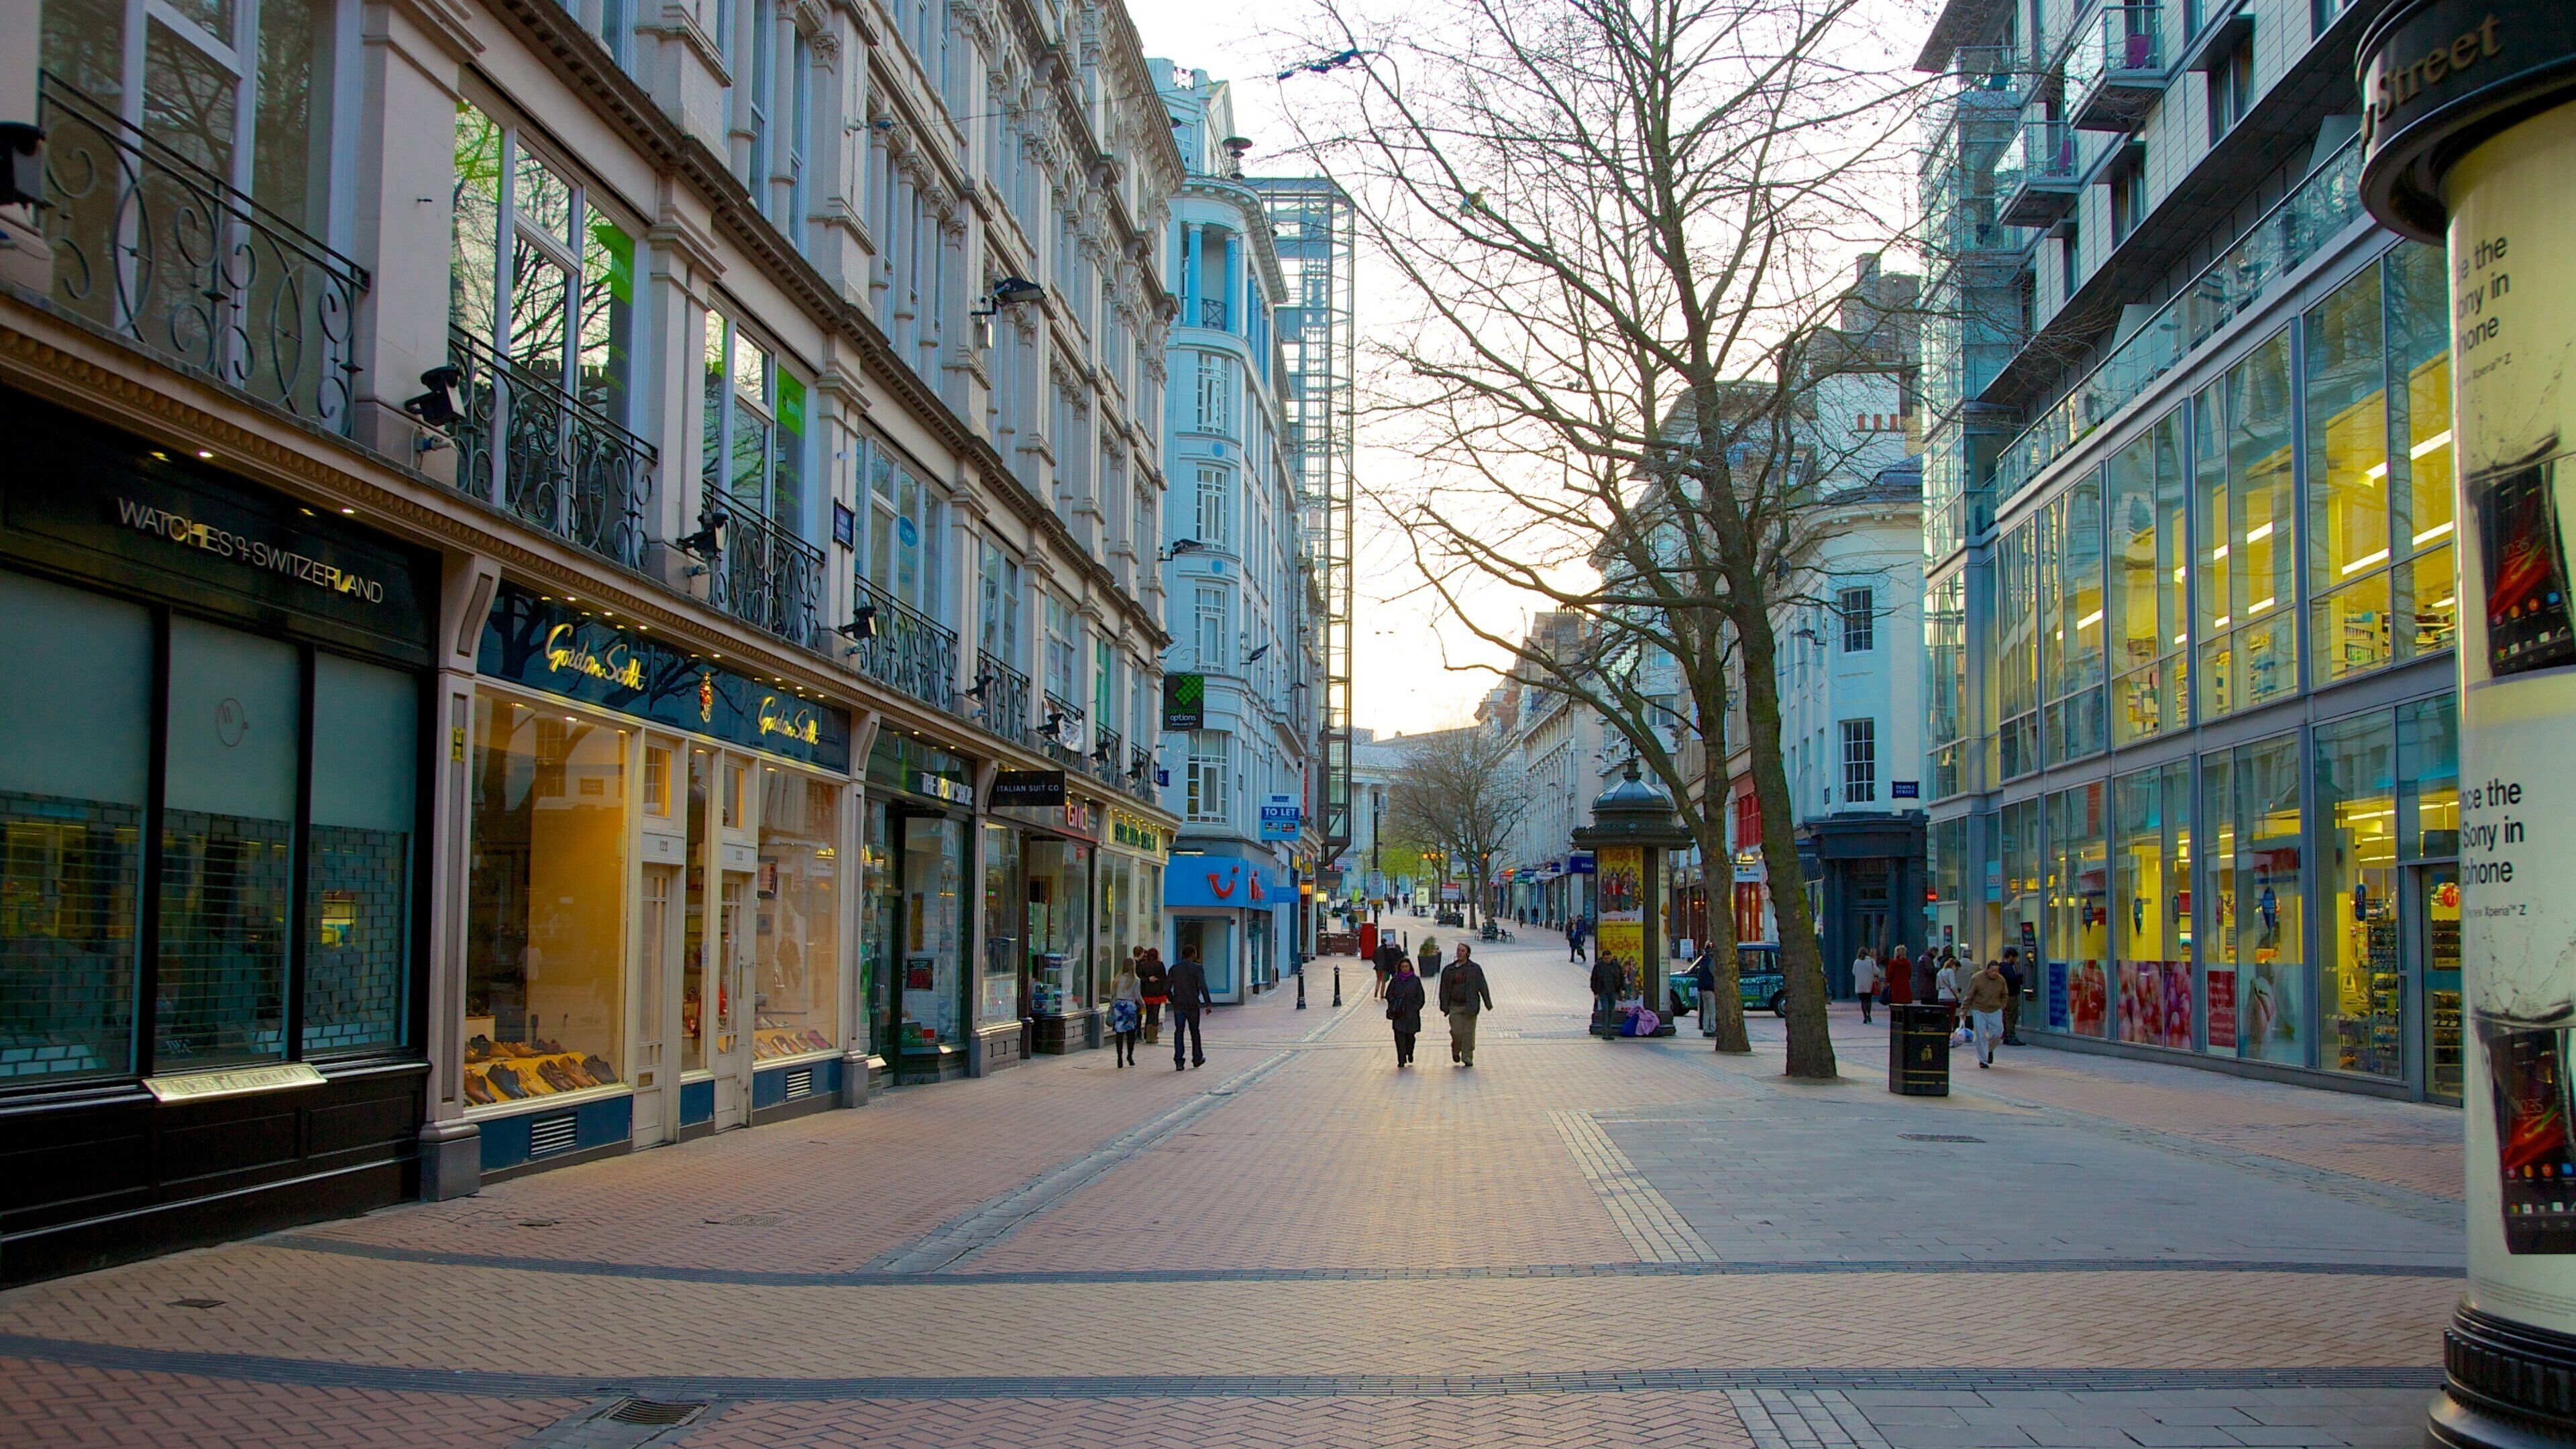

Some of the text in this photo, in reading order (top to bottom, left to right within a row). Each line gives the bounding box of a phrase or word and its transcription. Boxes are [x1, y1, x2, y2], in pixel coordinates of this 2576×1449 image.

[2377, 13, 2504, 122] Street
[2475, 237, 2508, 270] the
[2459, 272, 2509, 319] ony in
[2504, 352, 2512, 365] Z
[117, 497, 234, 557] WATCHES
[253, 542, 383, 603] SWITZERLAND
[544, 623, 644, 691] Gordon Scott
[757, 696, 819, 746] Gordon Scott
[1169, 714, 1197, 722] options
[453, 731, 464, 758] H
[920, 772, 973, 806] THE BODY SHOP
[2486, 778, 2522, 806] the
[1281, 808, 1296, 816] LET
[659, 840, 668, 852] 122
[2463, 816, 2524, 851] Sony in
[1986, 875, 2000, 884] TESCO
[2519, 905, 2526, 915] Z
